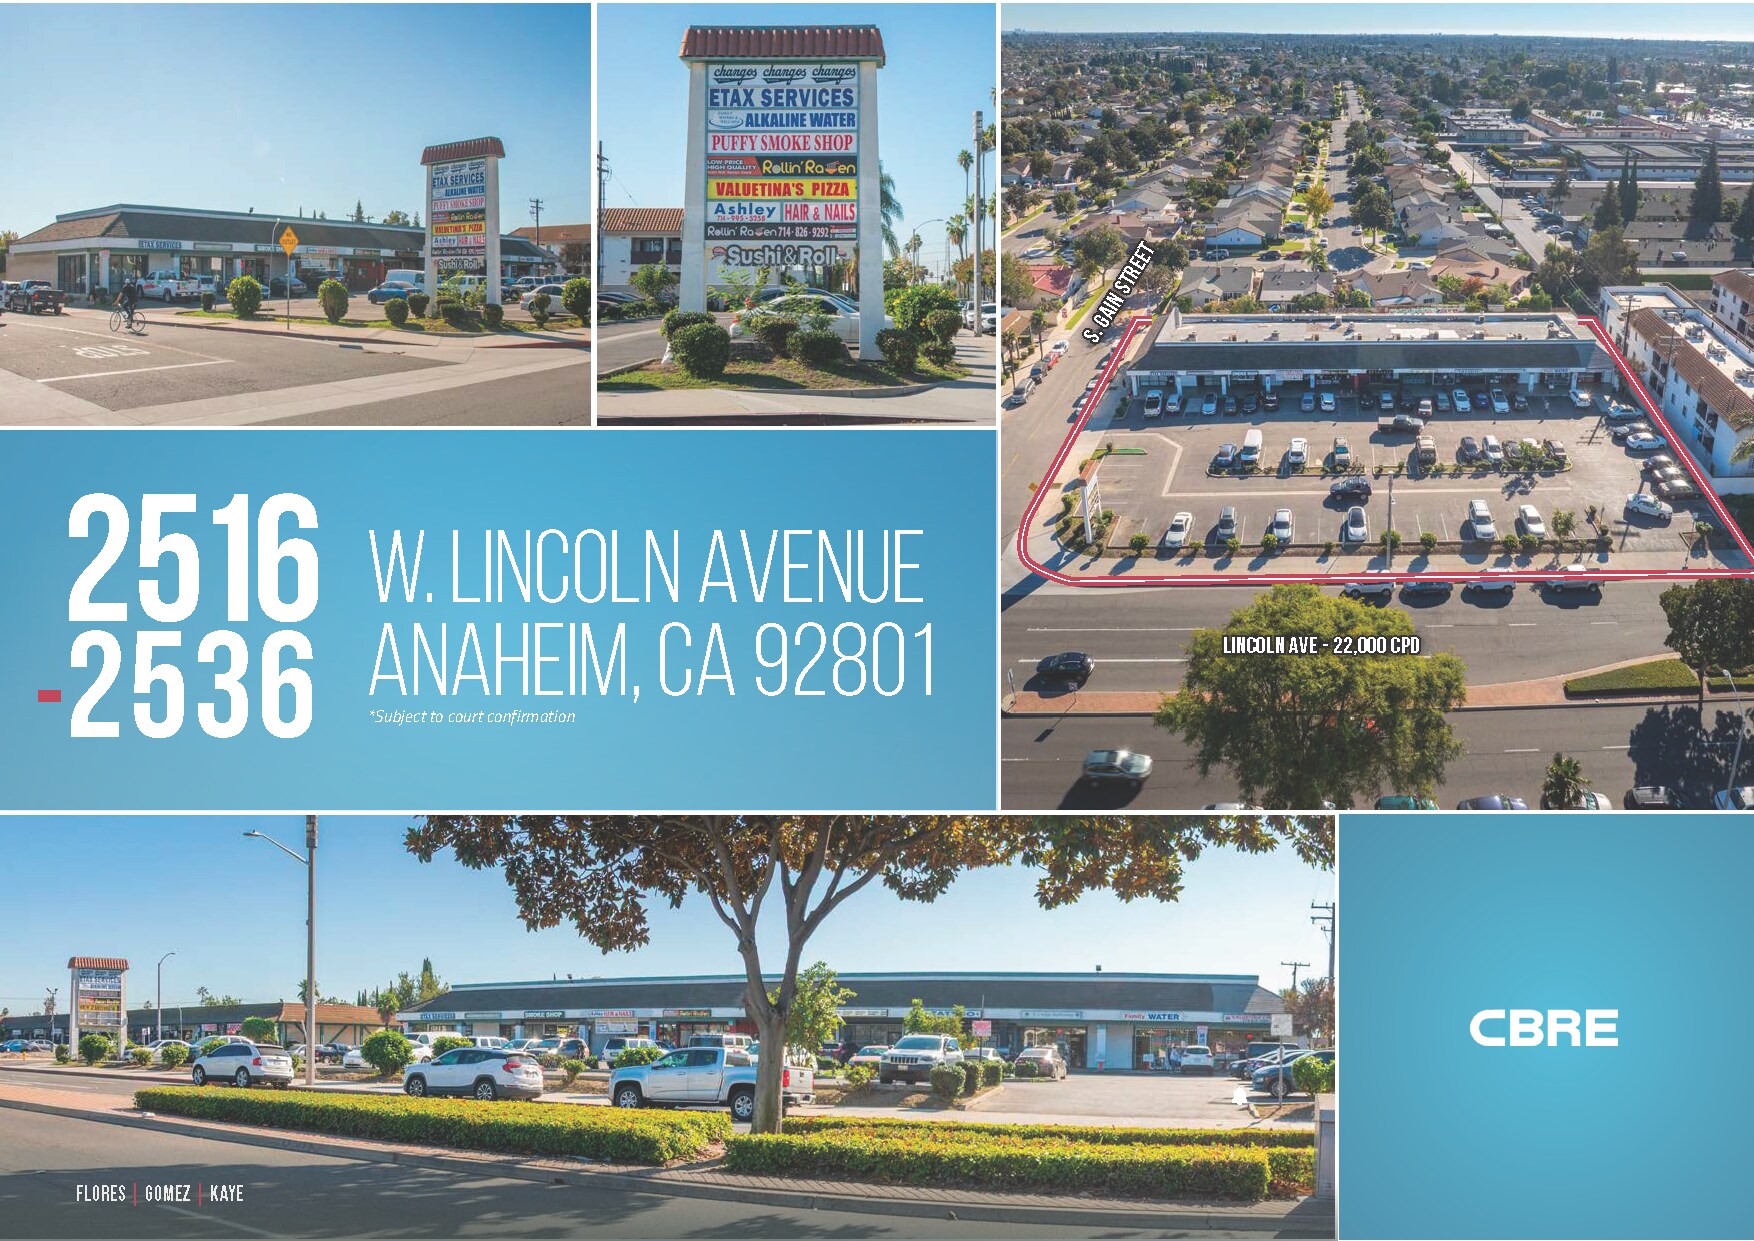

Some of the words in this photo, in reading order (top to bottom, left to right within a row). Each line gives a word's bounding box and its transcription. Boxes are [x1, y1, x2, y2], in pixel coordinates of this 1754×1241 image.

[714, 65, 757, 85] changos
[763, 65, 806, 85] changos
[812, 64, 856, 85] changos
[709, 89, 755, 107] ETAX
[761, 88, 854, 107] SERVICES
[745, 113, 807, 128] ALKALINE
[809, 113, 856, 128] WATER
[711, 134, 758, 151] PUFFY
[760, 134, 811, 151] SMOKE
[814, 134, 853, 151] SHOP
[805, 159, 856, 174] Raen
[433, 177, 448, 188] ETAX
[450, 172, 485, 186] SERVICES
[716, 182, 804, 197] VALUETINA'S
[811, 182, 850, 197] PIZZA
[714, 202, 776, 218] Ashley
[784, 204, 810, 221] HAIR
[812, 207, 821, 221] &
[824, 203, 856, 221] NAILS
[739, 225, 777, 237] Raen
